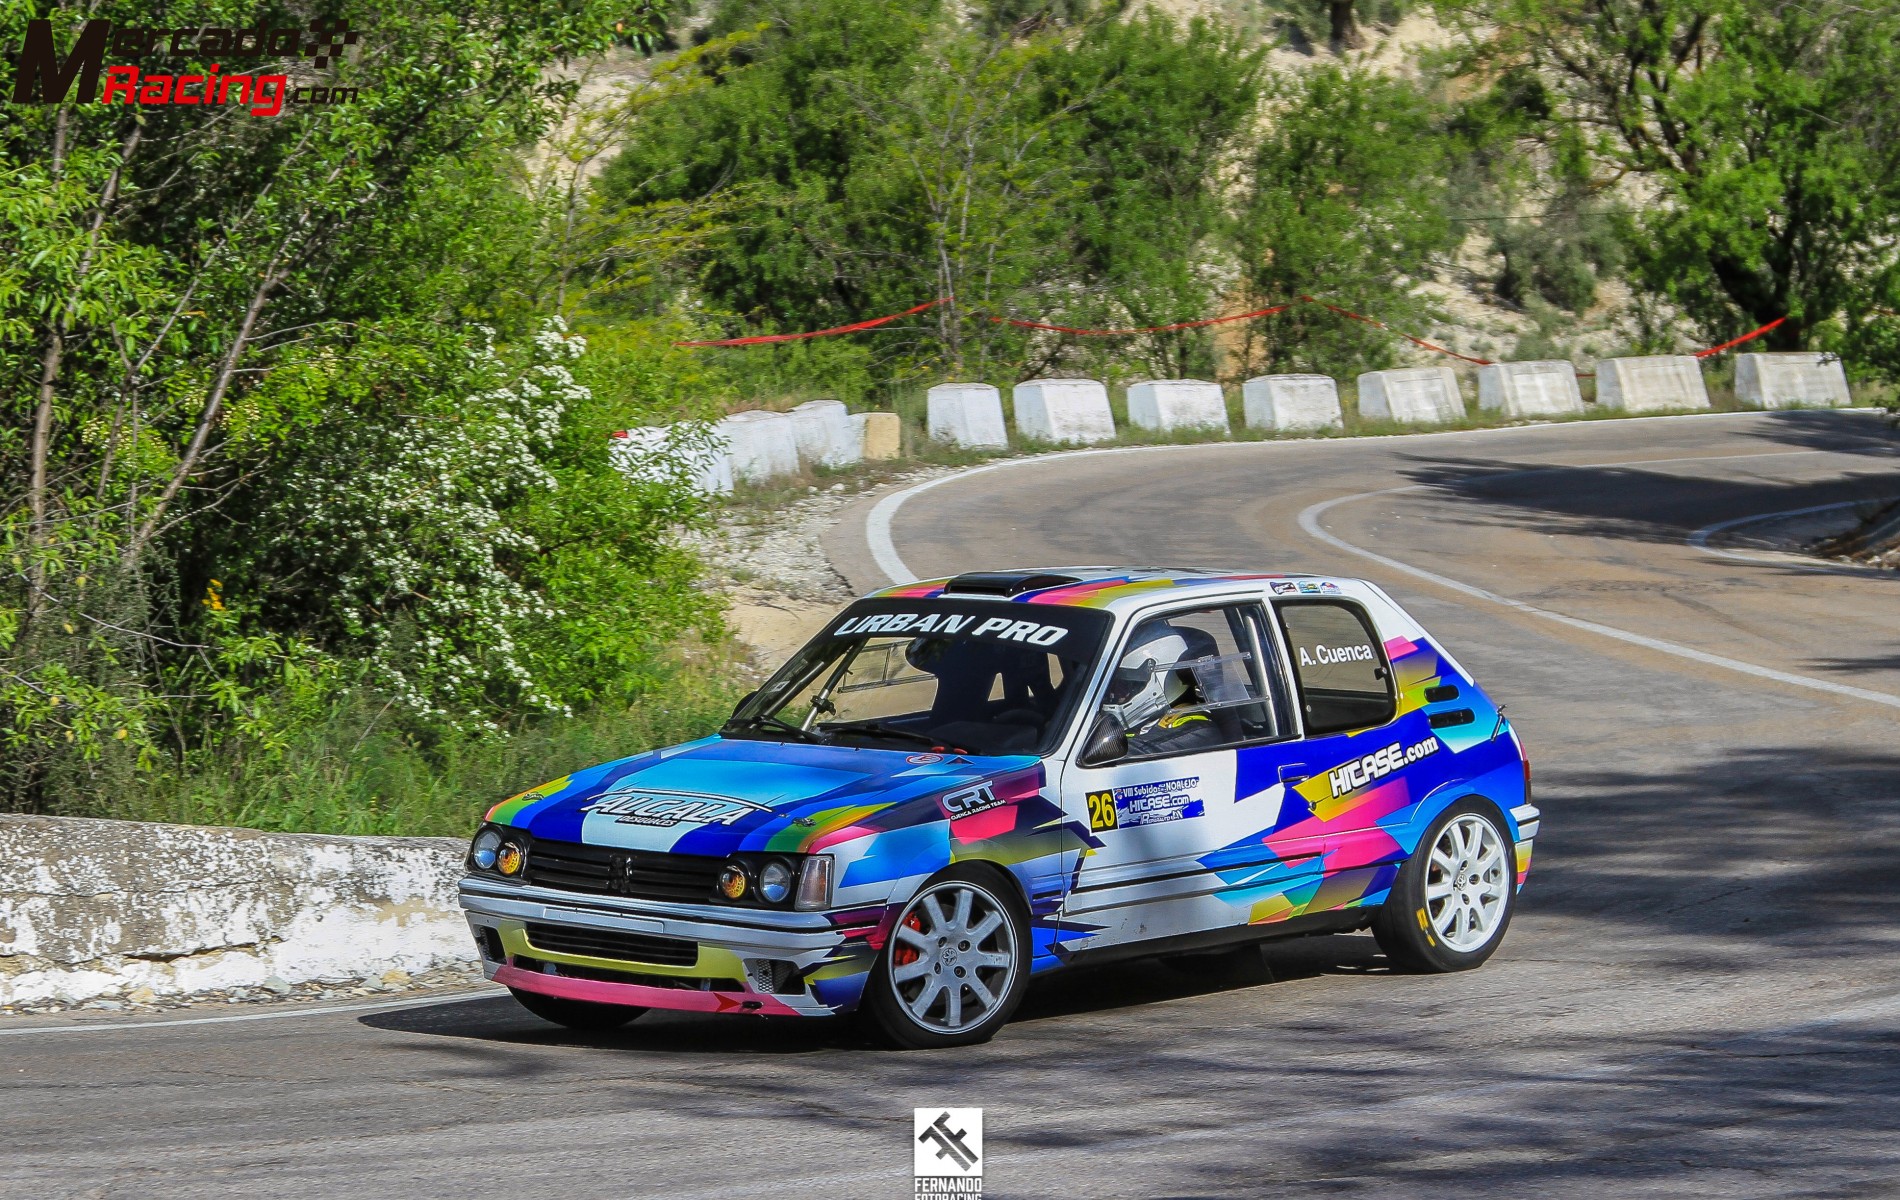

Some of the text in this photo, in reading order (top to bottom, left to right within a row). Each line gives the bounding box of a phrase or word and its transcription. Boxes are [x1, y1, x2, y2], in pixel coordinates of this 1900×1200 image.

[833, 613, 1069, 647] URBAN PRO
[1300, 643, 1374, 667] A. Cuenca
[580, 795, 757, 826] ALCALA
[942, 780, 996, 813] CRT
[950, 799, 1007, 821] CUENCA RACING TEAM
[1088, 792, 1116, 829] 26
